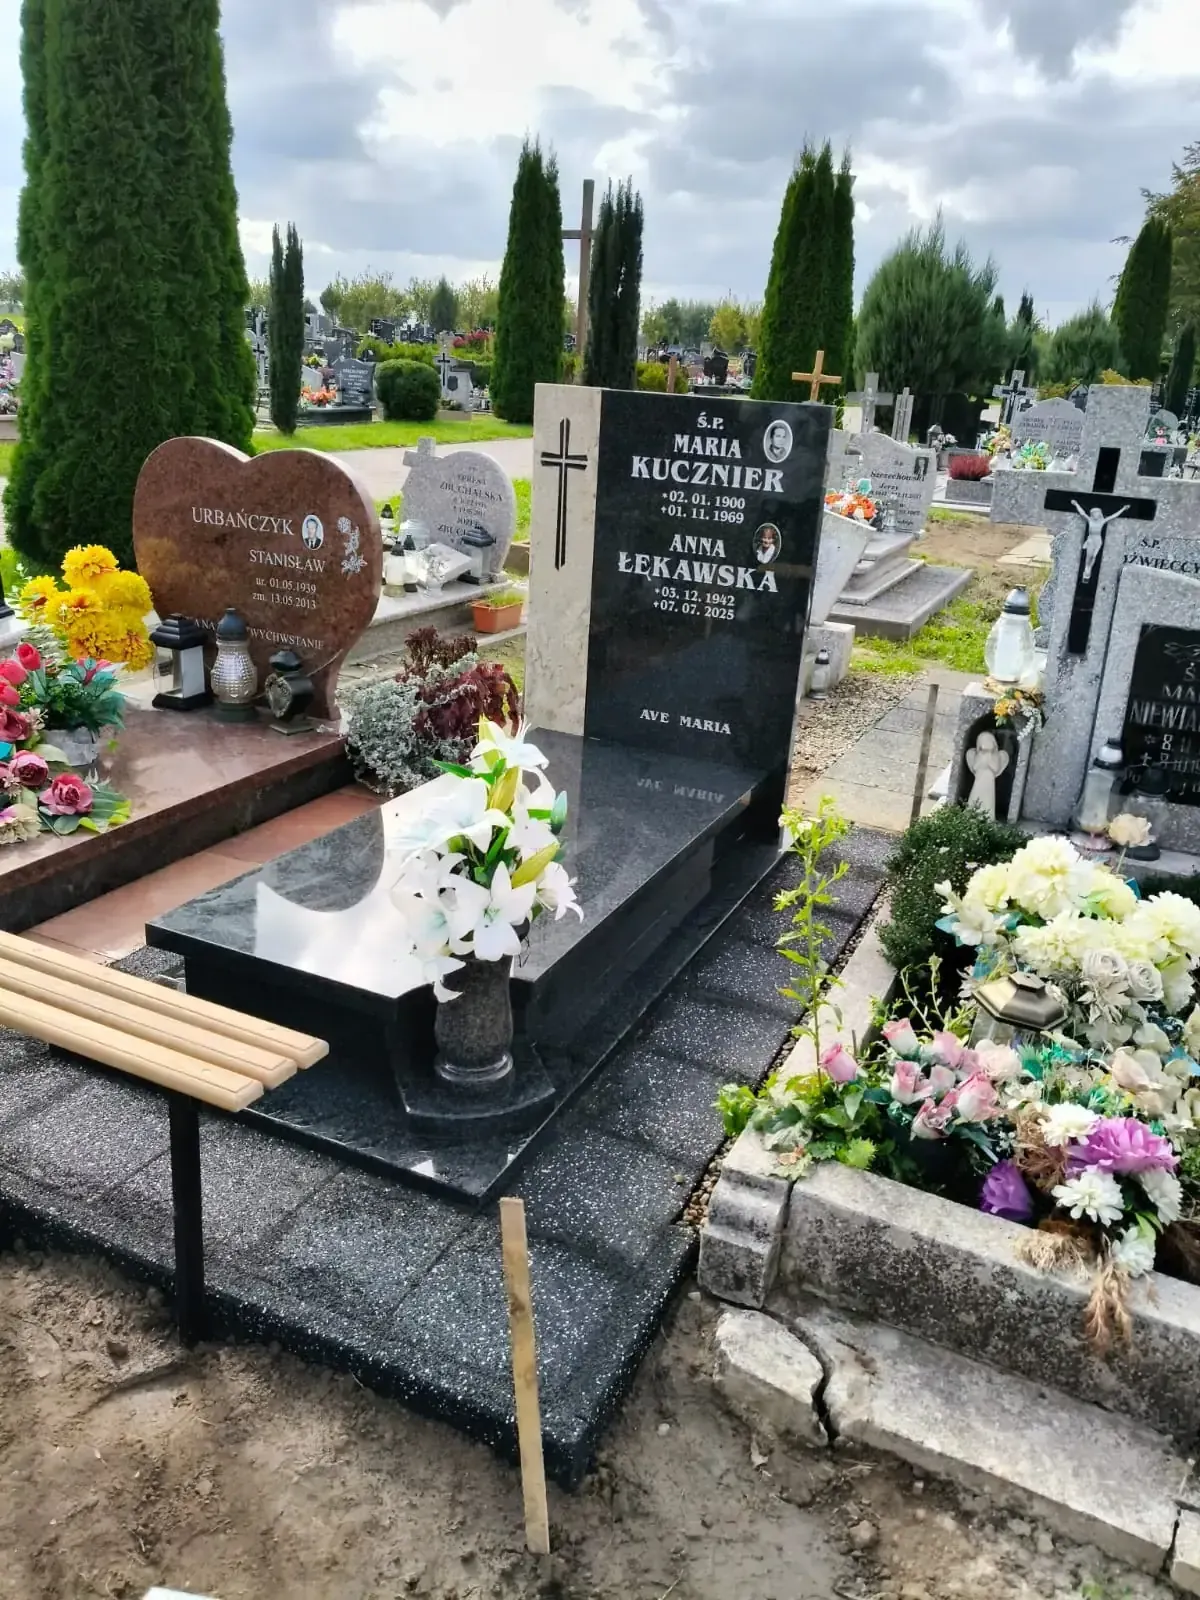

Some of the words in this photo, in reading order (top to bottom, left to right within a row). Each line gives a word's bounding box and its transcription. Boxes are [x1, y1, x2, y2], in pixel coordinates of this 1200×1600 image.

[697, 412, 724, 430] Ś.P.
[673, 434, 742, 459] MARIA
[630, 455, 784, 493] KUCZNIER
[191, 506, 294, 536] URBAŃCZYK
[669, 533, 726, 558] ANNA
[249, 549, 326, 573] STANISŁAW
[617, 551, 779, 593] ŁĘKAWSKA
[640, 709, 670, 724] AVE
[679, 715, 731, 735] MARIA
